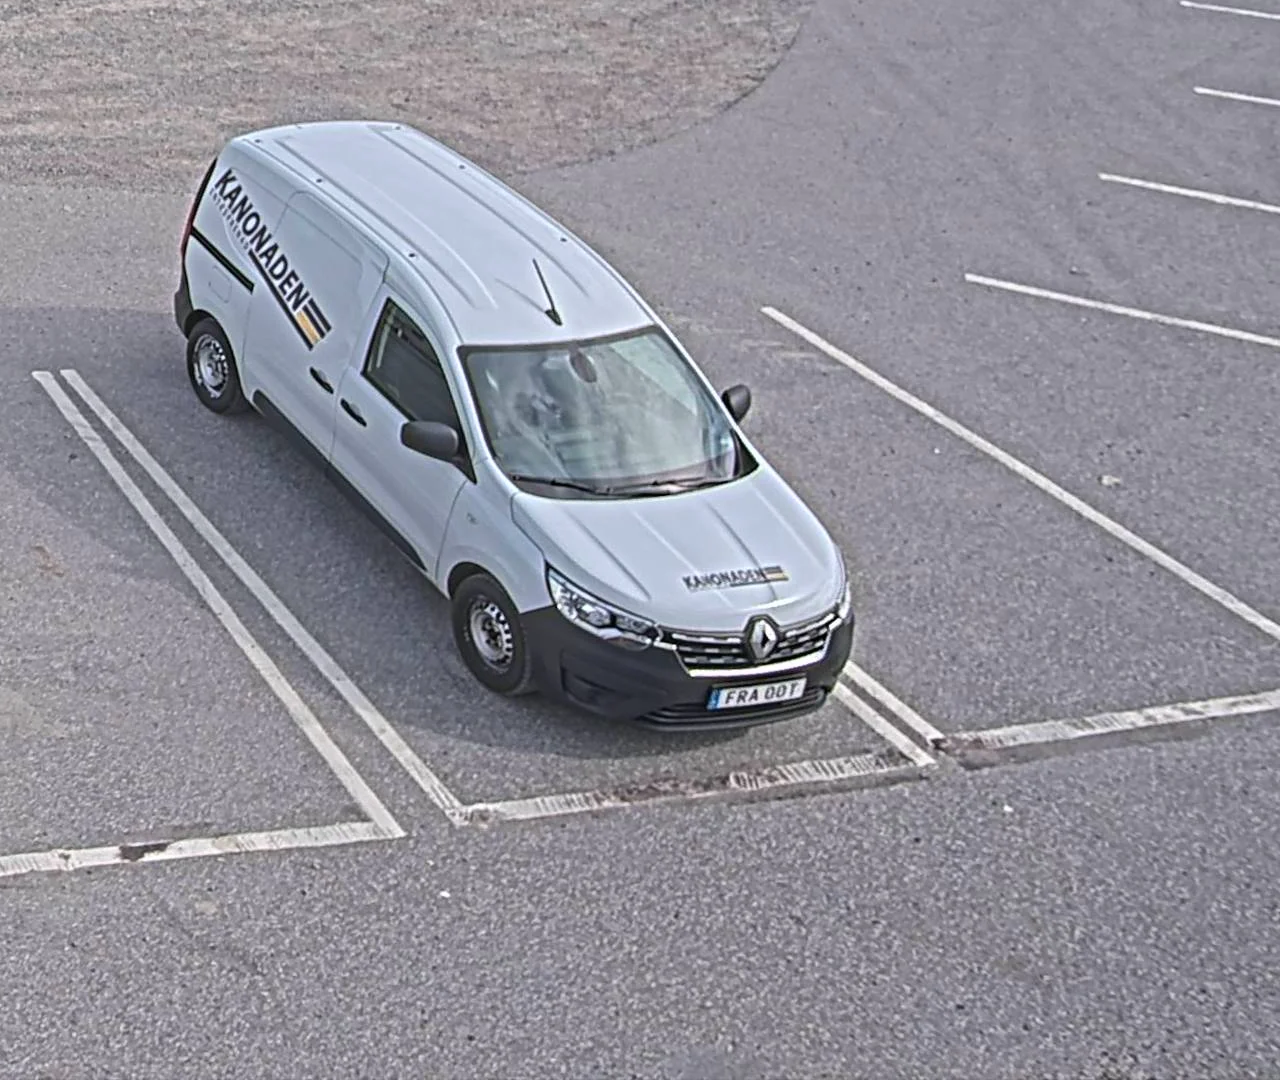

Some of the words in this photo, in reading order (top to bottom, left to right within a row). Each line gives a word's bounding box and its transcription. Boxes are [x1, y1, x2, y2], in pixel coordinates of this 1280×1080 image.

[214, 168, 310, 312] KANONADEN
[682, 568, 767, 589] KANONADEN
[725, 688, 759, 705] FRA
